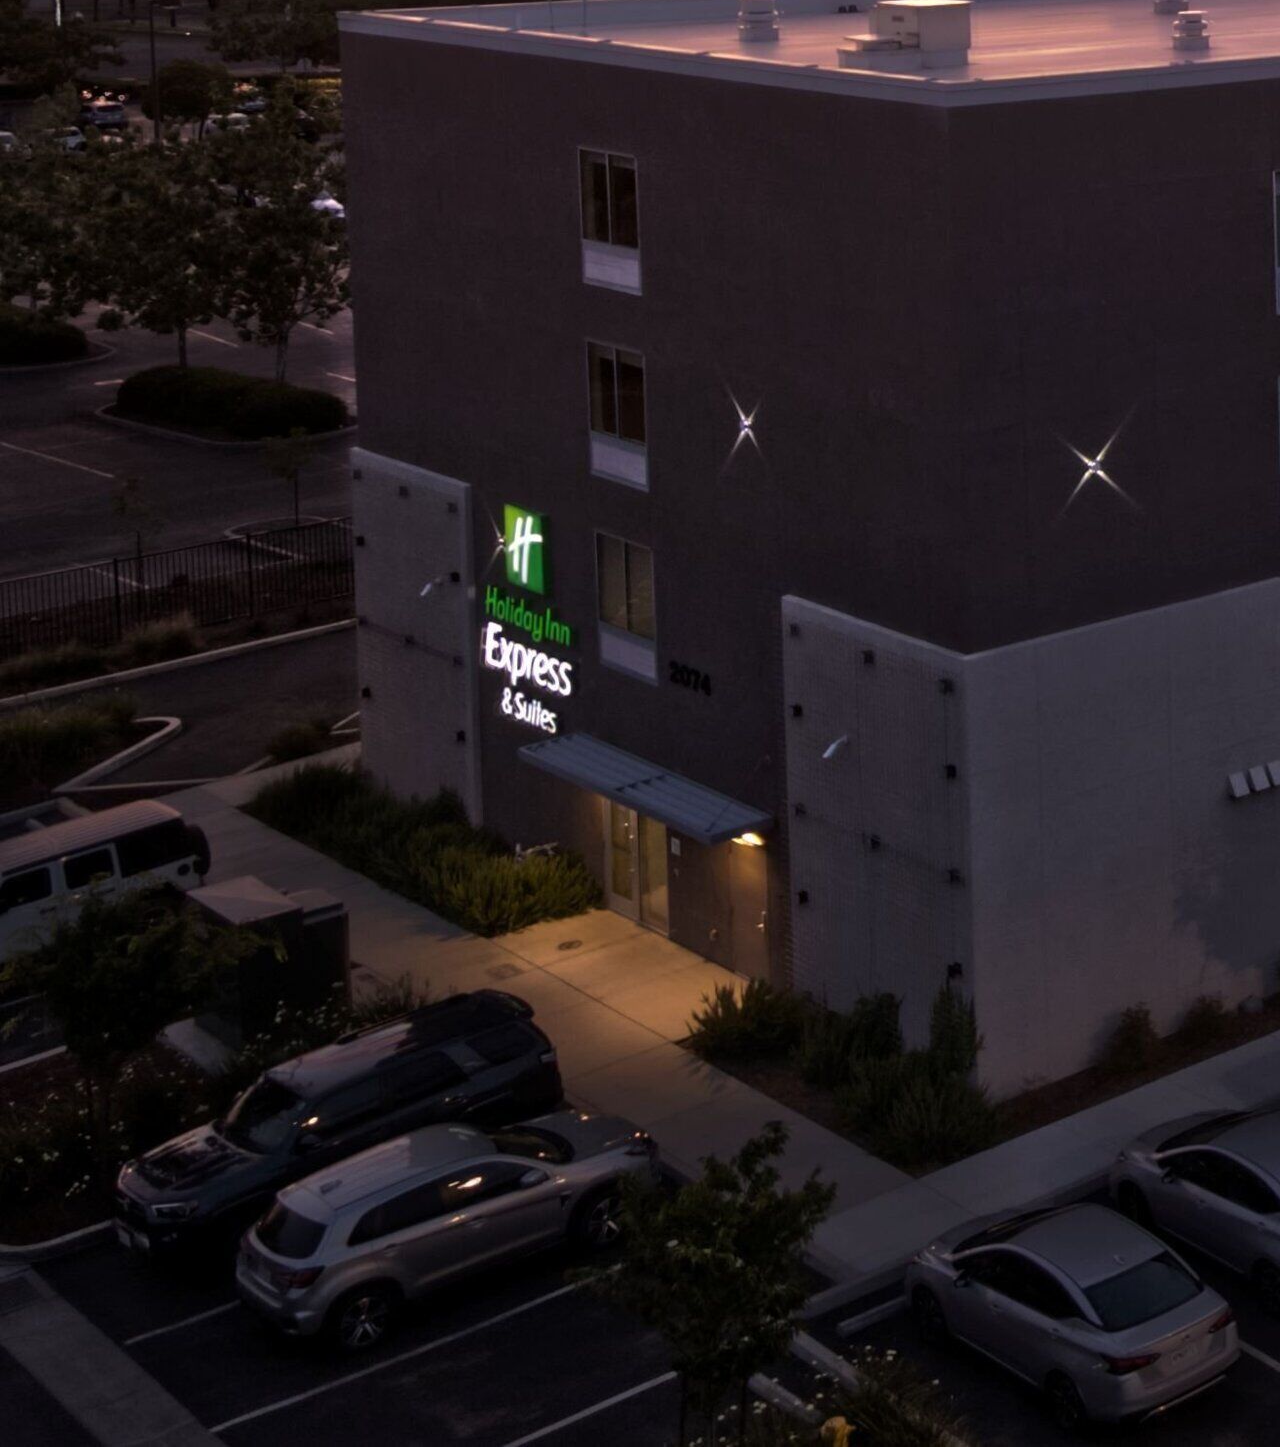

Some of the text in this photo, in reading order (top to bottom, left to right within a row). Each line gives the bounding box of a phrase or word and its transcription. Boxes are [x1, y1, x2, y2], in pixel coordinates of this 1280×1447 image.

[484, 585, 571, 647] Holiday Inn
[484, 621, 573, 696] Express
[501, 687, 558, 734] & Suites
